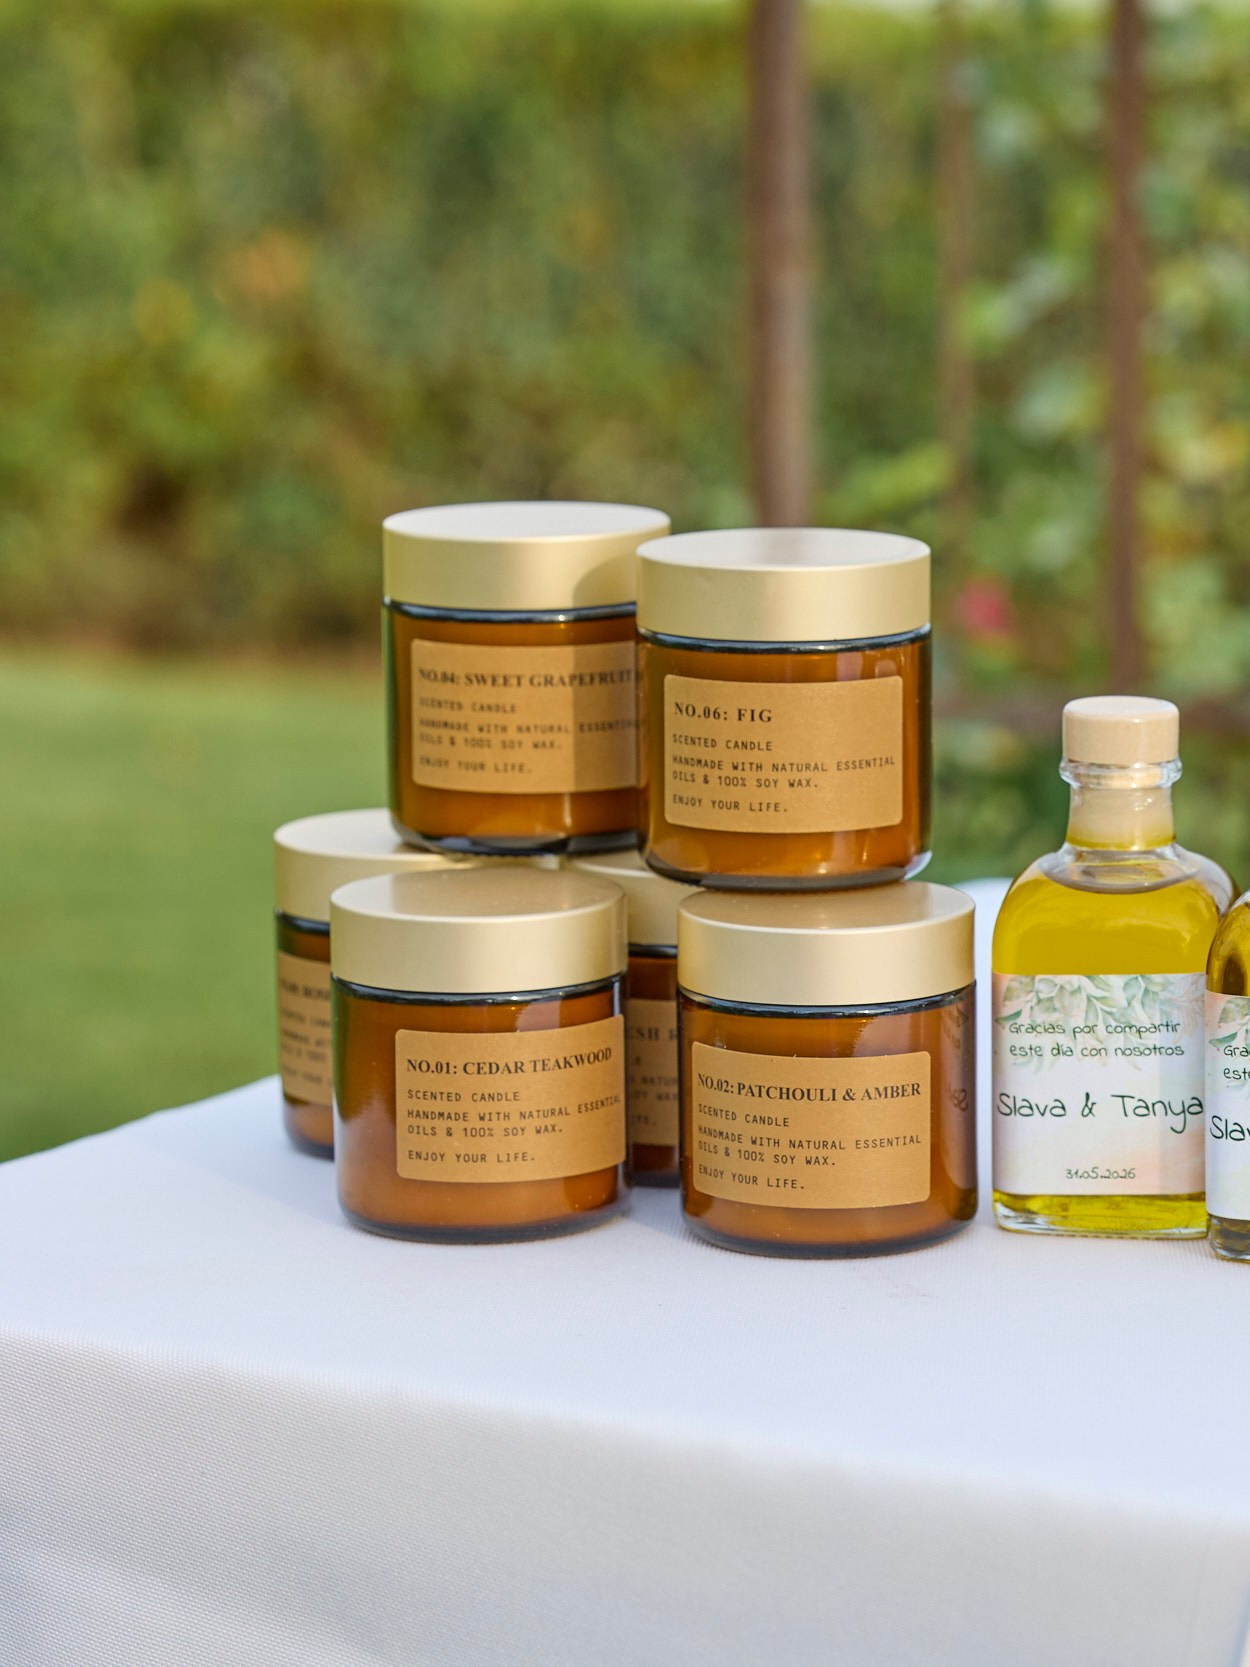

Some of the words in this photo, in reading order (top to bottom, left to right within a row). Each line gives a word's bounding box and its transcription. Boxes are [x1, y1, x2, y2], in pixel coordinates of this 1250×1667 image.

[418, 668, 458, 685] NO.04:
[464, 673, 523, 688] SWEET
[419, 697, 463, 710] SCENTED
[471, 702, 516, 713] CANDLE
[674, 702, 728, 720] NO.06:
[737, 708, 772, 722] FIG
[477, 723, 508, 733] WITH
[516, 724, 569, 734] NATURAL
[502, 739, 523, 749] SOY
[532, 740, 562, 750] WAX.
[672, 734, 717, 749] SCENTED
[726, 740, 772, 751] CANDLE
[458, 760, 486, 772] YOUR
[494, 762, 532, 773] LIFE.
[672, 755, 723, 770] HANDMADE
[732, 761, 763, 772] WITH
[772, 762, 827, 772] NATURAL
[836, 756, 895, 771] ESSENTIAL
[672, 772, 696, 783] OILS
[703, 774, 709, 785] &
[718, 776, 747, 787] 100%
[756, 778, 778, 788] SOY
[788, 778, 819, 788] WAX.
[672, 794, 702, 808] ENJOY
[711, 800, 740, 811] YOUR
[750, 802, 788, 812] LIFE.
[1009, 1022, 1065, 1034] Gracias
[1073, 1024, 1098, 1040] por
[1106, 1022, 1181, 1038] compartir
[1010, 1044, 1042, 1056] este
[1051, 1043, 1073, 1056] día
[1081, 1047, 1108, 1057] con
[1115, 1044, 1184, 1057] nosotros
[407, 1059, 457, 1075] NO.01:
[462, 1061, 525, 1076] CEDAR
[530, 1047, 612, 1072] TEAKWOOD
[698, 1073, 734, 1094] NO.02:
[737, 1083, 837, 1101] PATCHOULI
[842, 1089, 855, 1101] &
[861, 1083, 921, 1101] AMBER
[408, 1090, 462, 1102] SCENTED
[472, 1092, 520, 1102] CANDLE
[408, 1108, 469, 1122] HANDMADE
[479, 1112, 510, 1122] WITH
[520, 1106, 570, 1120] NATURAL
[578, 1095, 621, 1114] ESSENTIAL
[698, 1103, 737, 1121] SCENTED
[745, 1114, 789, 1127] CANDLE
[997, 1093, 1066, 1117] Slava
[1081, 1092, 1097, 1117] &
[1111, 1094, 1204, 1134] Tanya
[408, 1126, 438, 1136] OILS
[446, 1127, 453, 1136] &
[462, 1127, 494, 1138] 100%
[504, 1126, 526, 1137] SOY
[536, 1124, 563, 1134] WAX.
[698, 1125, 743, 1144] HANDMADE
[751, 1136, 780, 1148] WITH
[789, 1139, 846, 1150] NATURAL
[855, 1134, 921, 1149] ESSENTIAL
[408, 1151, 446, 1162] ENJOY
[456, 1152, 487, 1163] YOUR
[497, 1151, 536, 1162] LIFE.
[698, 1141, 718, 1155] OILS
[724, 1146, 730, 1157] &
[738, 1150, 764, 1162] 100%
[774, 1154, 795, 1165] SOY
[805, 1155, 836, 1166] WAX.
[698, 1164, 724, 1179] ENJOY
[732, 1173, 758, 1186] YOUR
[767, 1177, 805, 1190] LIFE.
[1066, 1167, 1136, 1179] 31.05.2026
